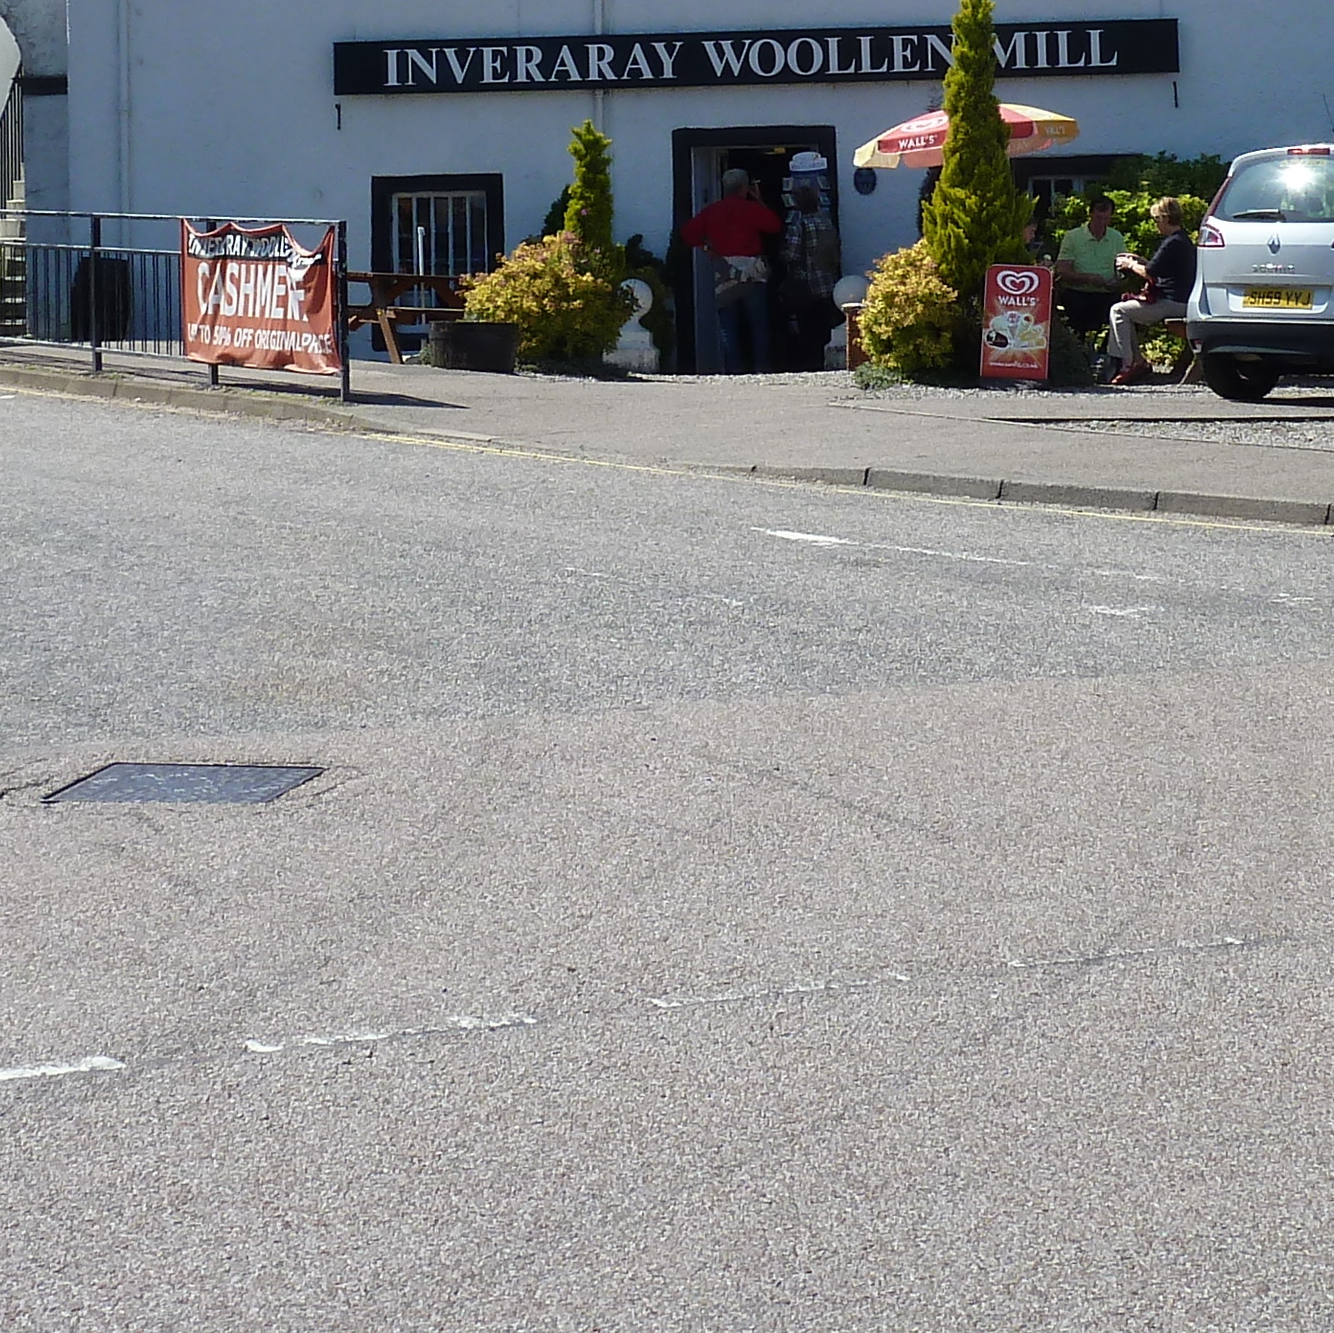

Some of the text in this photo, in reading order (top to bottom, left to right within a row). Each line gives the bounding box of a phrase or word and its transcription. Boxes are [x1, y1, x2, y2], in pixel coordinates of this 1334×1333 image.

[382, 29, 1119, 87] INVERARAY WOOLLEN MILL
[898, 134, 936, 150] WALL'S
[998, 295, 1037, 306] WALL'S
[1249, 290, 1312, 306] SH59 YYJ
[199, 324, 211, 344] TO
[234, 327, 255, 348] OFF
[255, 329, 301, 351] ORIGINAL
